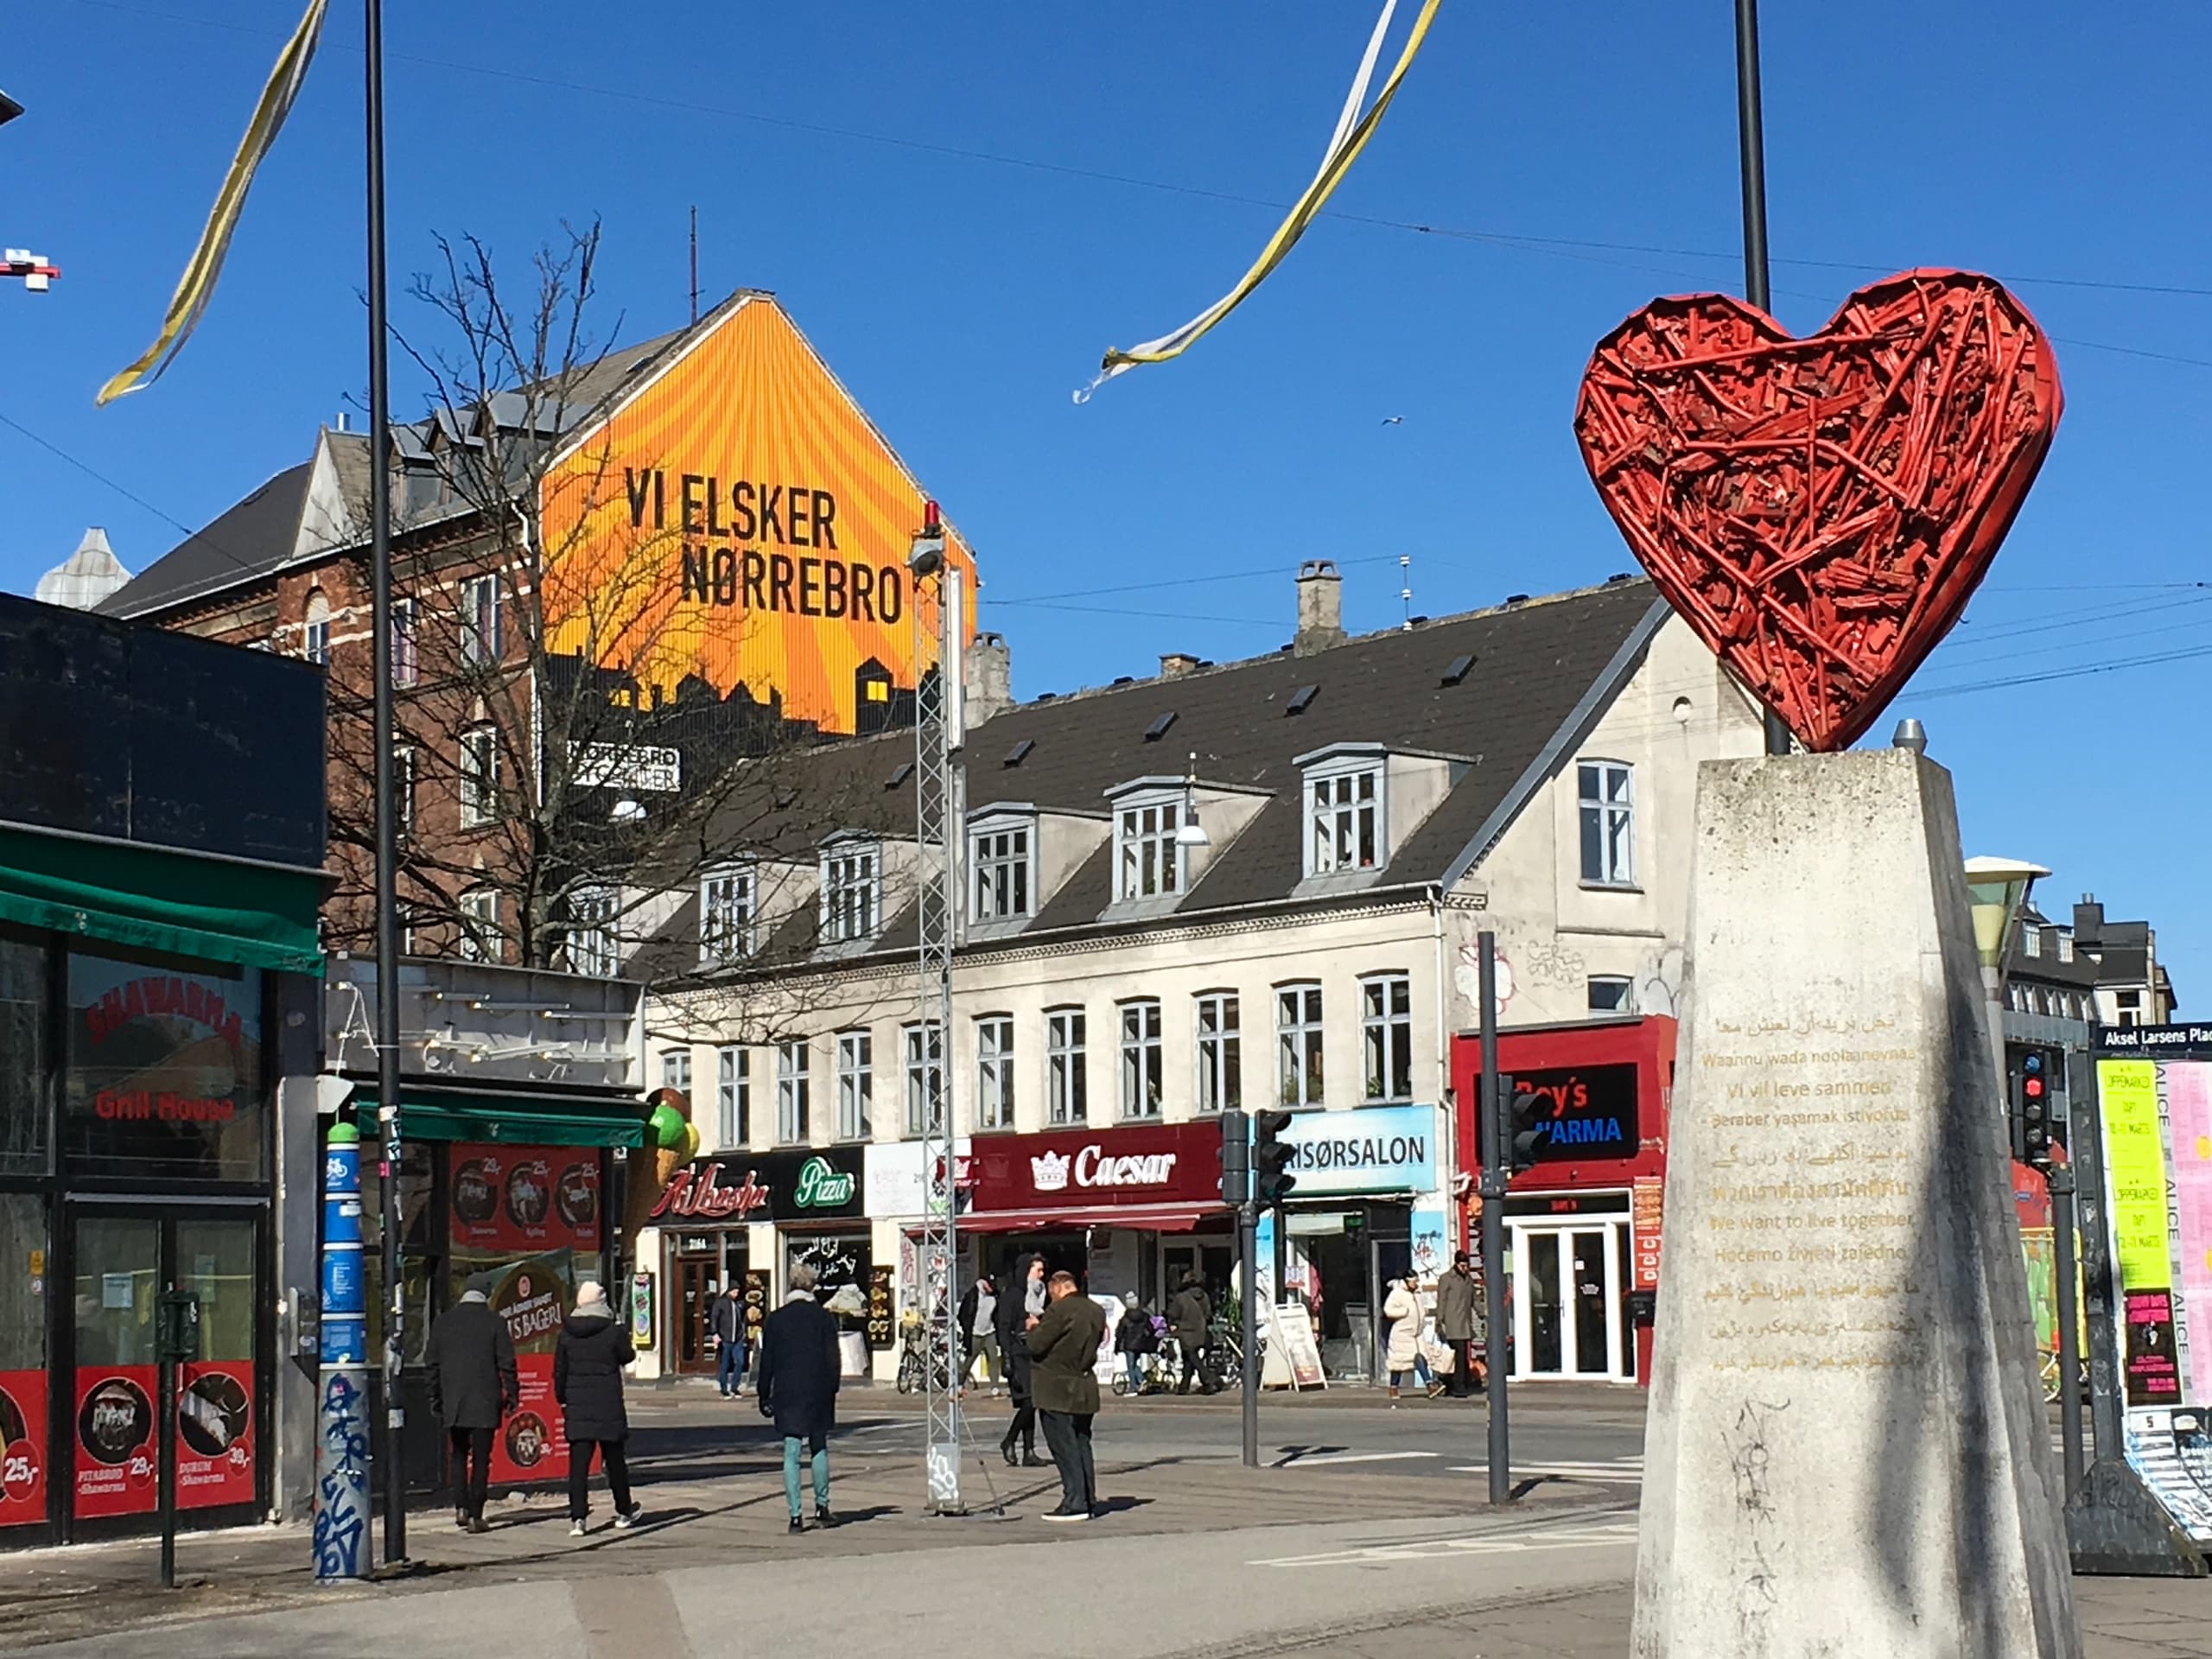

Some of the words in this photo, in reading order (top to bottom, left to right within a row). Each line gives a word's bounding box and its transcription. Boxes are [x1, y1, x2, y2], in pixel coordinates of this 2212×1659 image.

[625, 467, 664, 531] VI
[682, 474, 837, 550] ELSKER
[681, 543, 901, 625] NØRREBRO
[87, 976, 242, 1051] SHAWARMA
[2105, 1030, 2139, 1046] Aksel
[2141, 1030, 2186, 1045] Larsens
[1767, 1049, 1807, 1065] wada
[96, 1090, 149, 1120] Grill
[157, 1091, 236, 1121] House
[1727, 1083, 1744, 1098] Vi
[1749, 1081, 1769, 1097] vil
[1774, 1080, 1810, 1097] leve
[1815, 1080, 1892, 1096] sammen
[2155, 1065, 2171, 1127] ALICE
[1075, 1145, 1176, 1187] Caesar
[1284, 1136, 1425, 1169] ISØRSALON
[795, 1157, 853, 1207] Pizza
[1709, 1215, 1735, 1230] We
[1740, 1215, 1781, 1230] want
[1787, 1213, 1803, 1228] to
[1808, 1212, 1836, 1228] live
[1840, 1211, 1913, 1230] together
[2165, 1179, 2180, 1241] ALICE
[1841, 1243, 1906, 1262] zajedno
[522, 1302, 563, 1338] BAGERI
[2172, 1293, 2190, 1355] ALICE
[4, 1457, 39, 1484] 25,-
